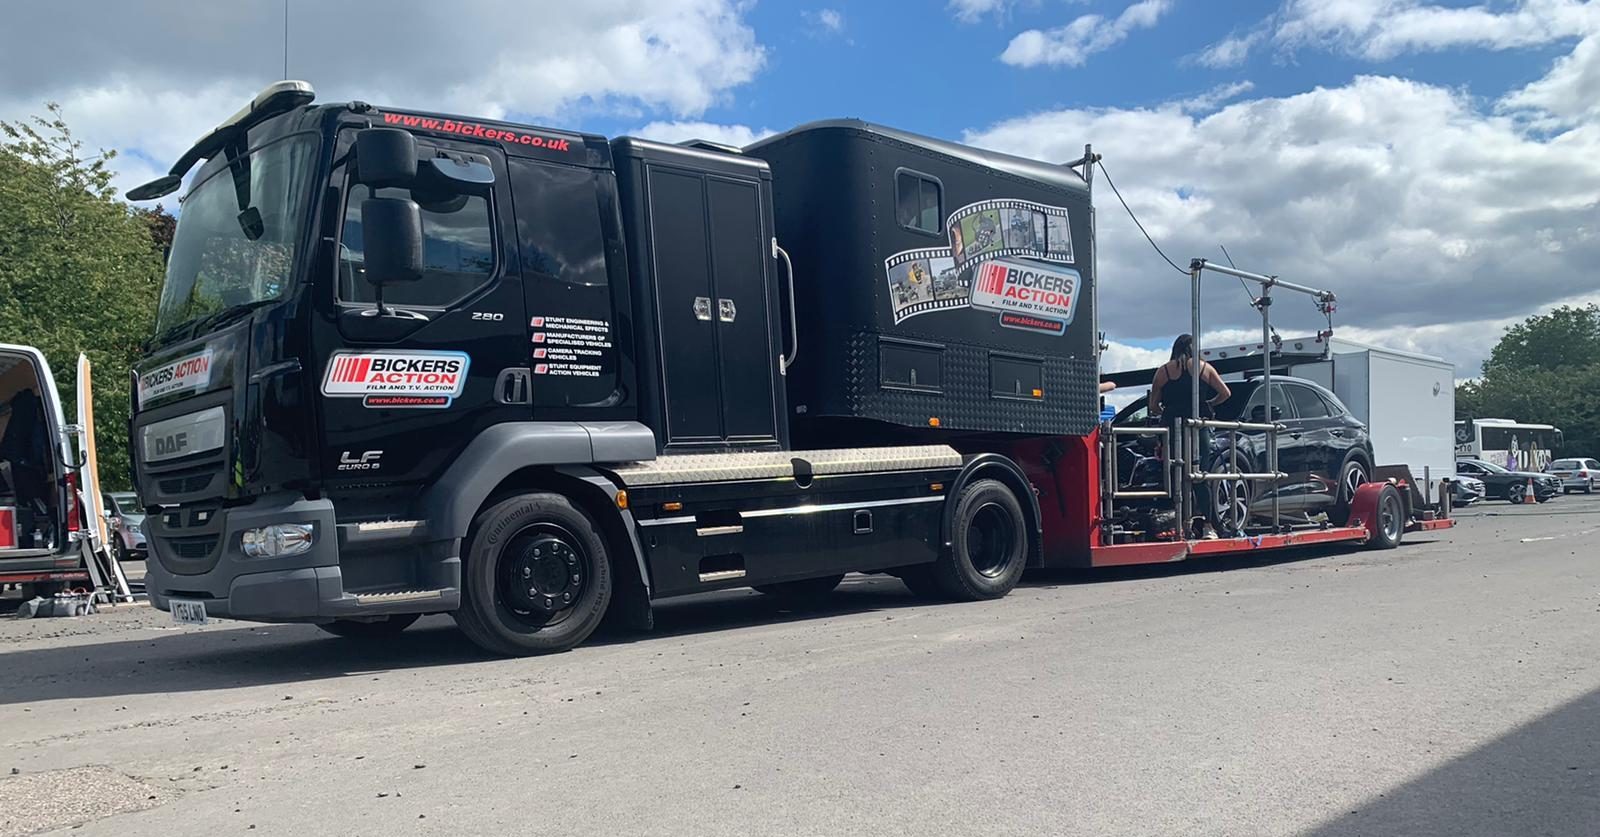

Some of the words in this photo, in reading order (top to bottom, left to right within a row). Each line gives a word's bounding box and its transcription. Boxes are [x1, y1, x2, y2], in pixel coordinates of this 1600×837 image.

[384, 112, 570, 151] www.bickers.co.uk
[1006, 268, 1074, 294] BICKERS
[1005, 286, 1071, 307] ACTION
[1002, 299, 1018, 307] FILM
[1045, 307, 1069, 315] ACTION
[472, 312, 504, 321] 280
[566, 318, 604, 326] ENGINEERING
[1003, 315, 1062, 330] www.bickers.co.uk
[545, 323, 584, 331] MECHANICAL
[546, 332, 597, 341] MANUFACTURERS
[547, 338, 585, 346] SPECIALISED
[371, 358, 460, 373] BICKERS
[144, 366, 174, 390] BICKERS
[174, 356, 210, 379] ACTION
[369, 373, 457, 384] ACTION
[368, 396, 447, 405] www.bickers.co.uk
[155, 432, 187, 455] DAF
[340, 450, 384, 463] LF
[337, 463, 371, 471] EURO
